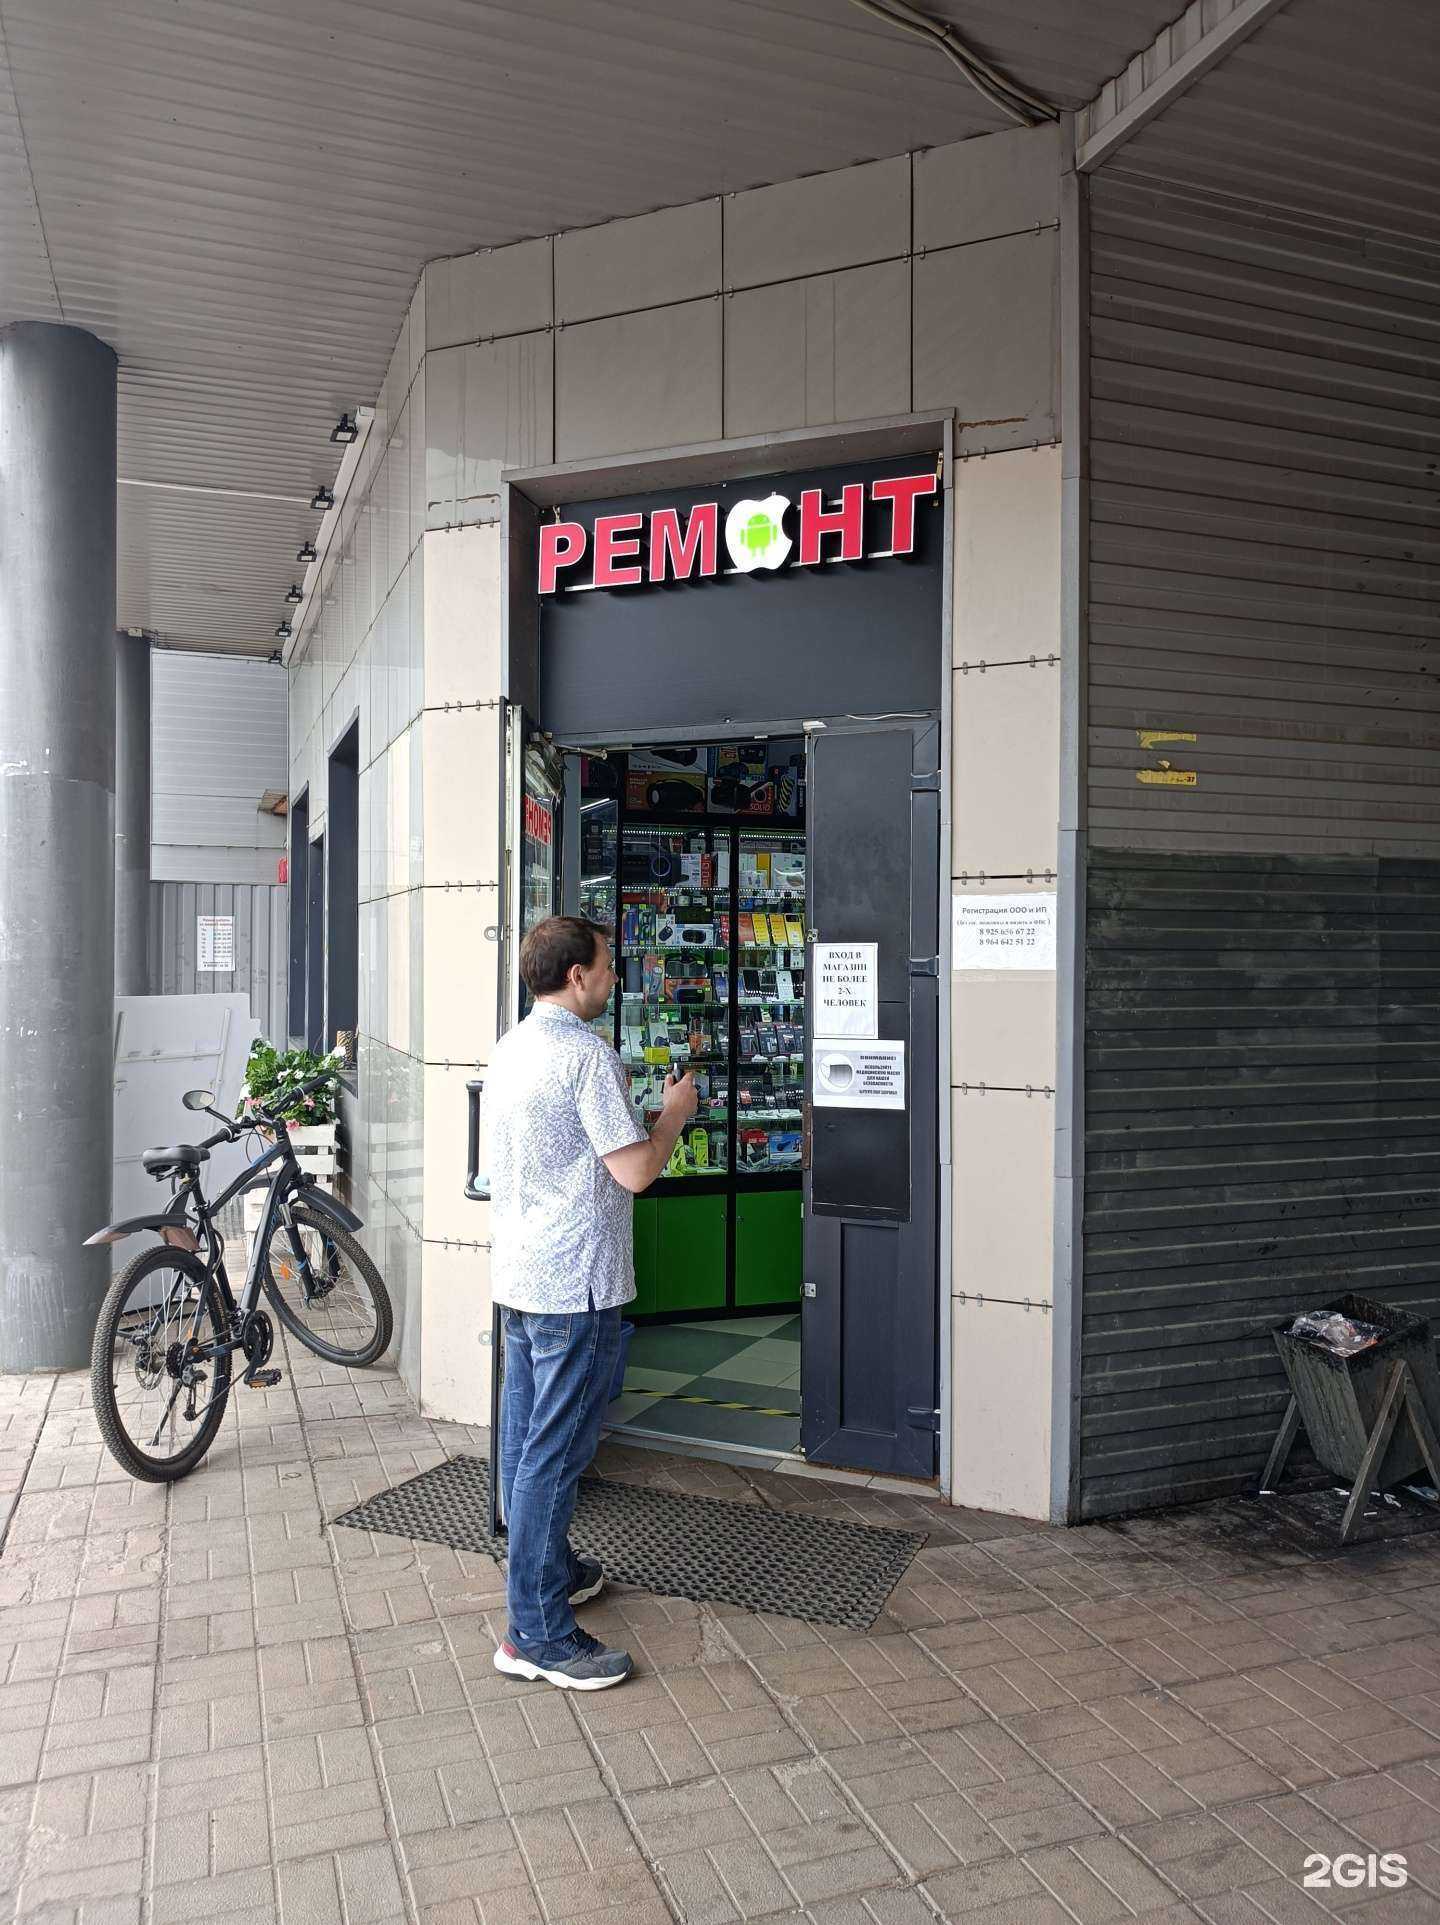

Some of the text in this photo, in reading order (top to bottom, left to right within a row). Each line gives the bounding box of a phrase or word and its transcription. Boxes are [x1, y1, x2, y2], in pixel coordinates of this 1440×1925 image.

[962, 907, 1008, 915] Регистрация
[1009, 906, 1027, 914] ООО
[829, 951, 862, 960] ВХОД В
[823, 963, 867, 971] МАГАЗИН
[823, 975, 868, 983] НЕ БОЛЕЕ
[823, 999, 867, 1007] ЧЕЛОВЕК
